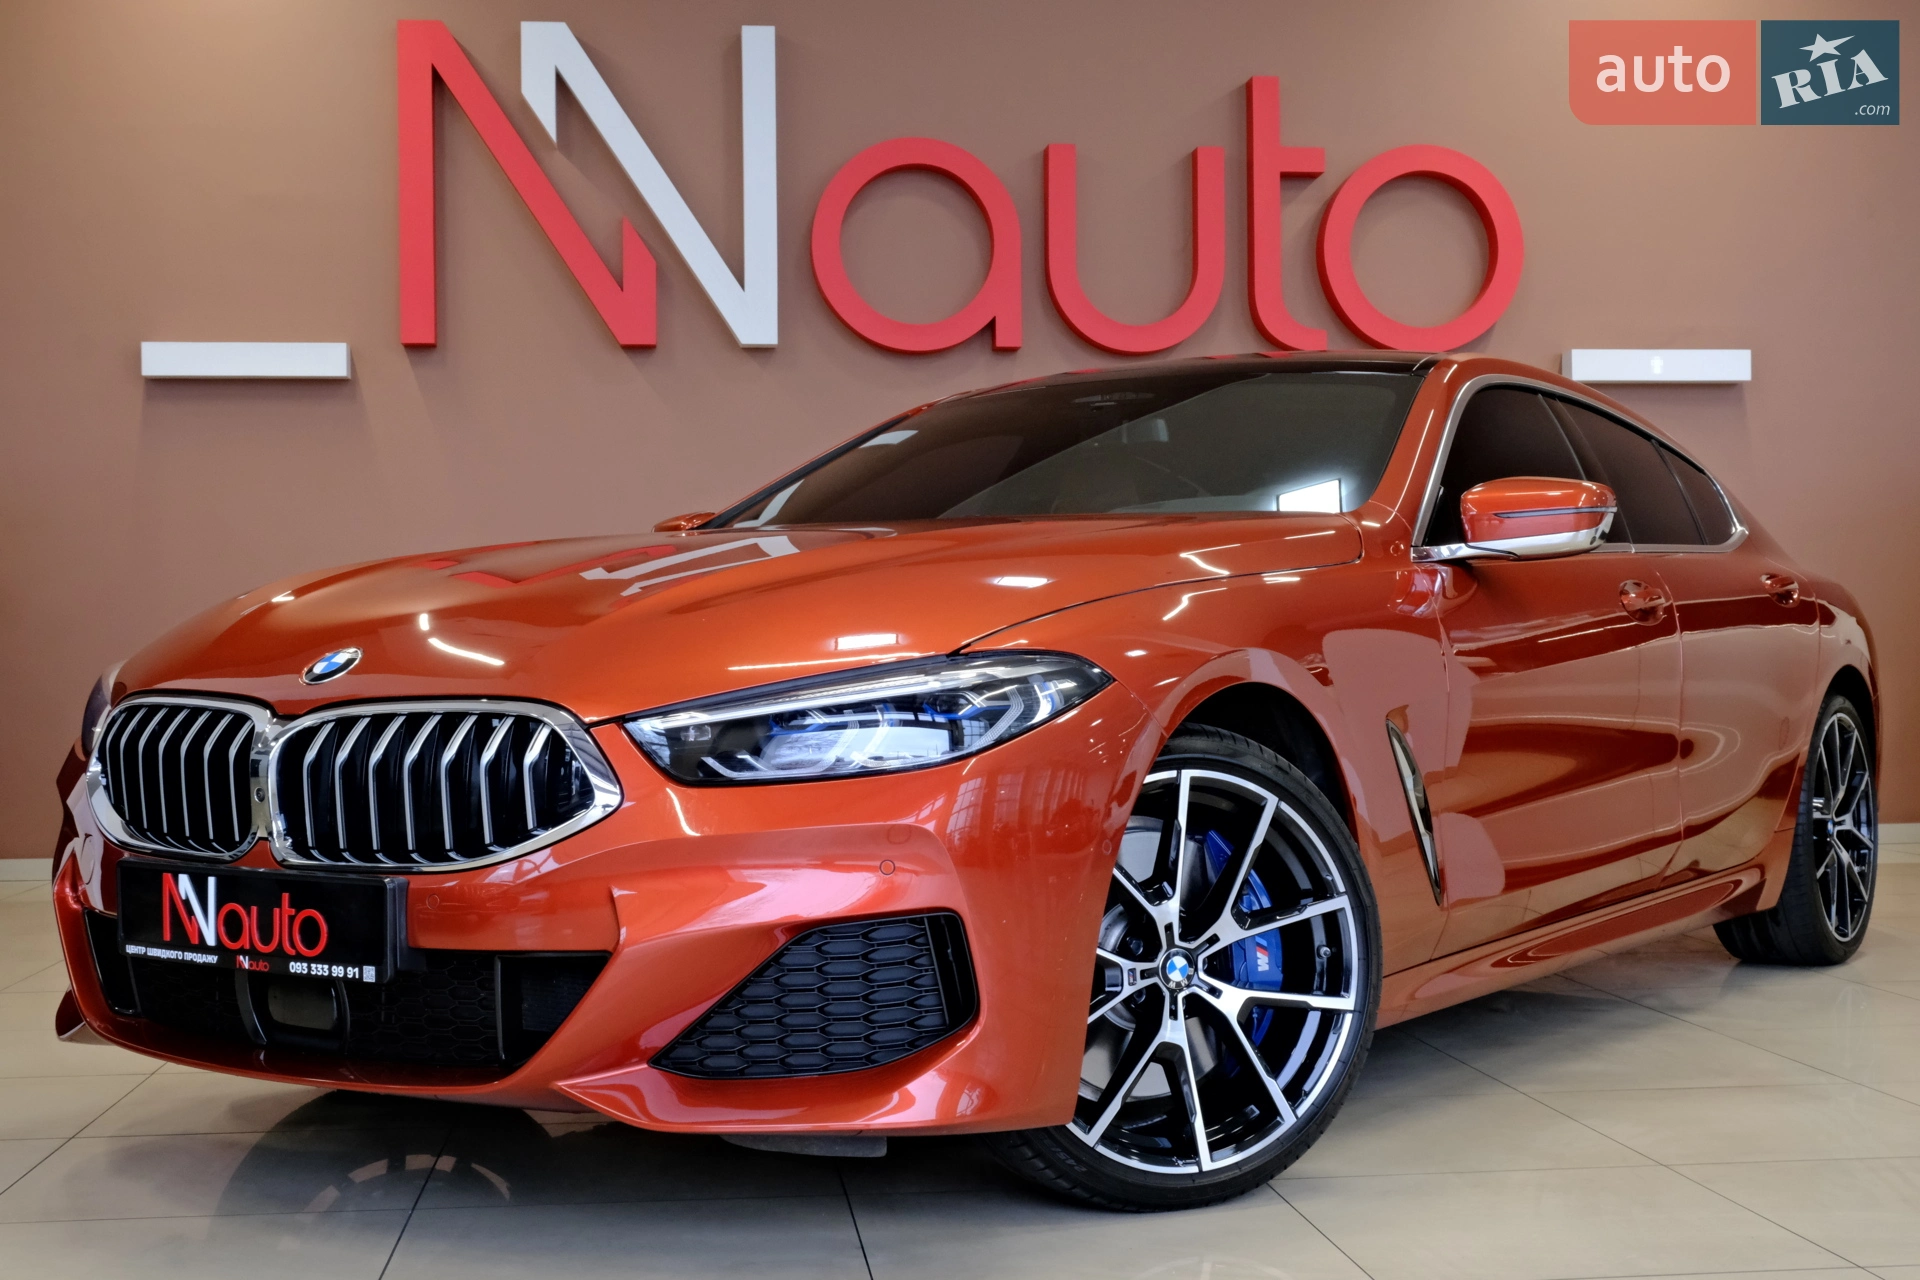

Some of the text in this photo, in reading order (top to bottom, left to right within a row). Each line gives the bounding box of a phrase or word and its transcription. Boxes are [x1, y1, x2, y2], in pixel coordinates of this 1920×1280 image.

[125, 944, 218, 964] ЦЕНТР ШВИДКОГО ПРОДАЖУ
[289, 961, 359, 979] 093 333 99 91
